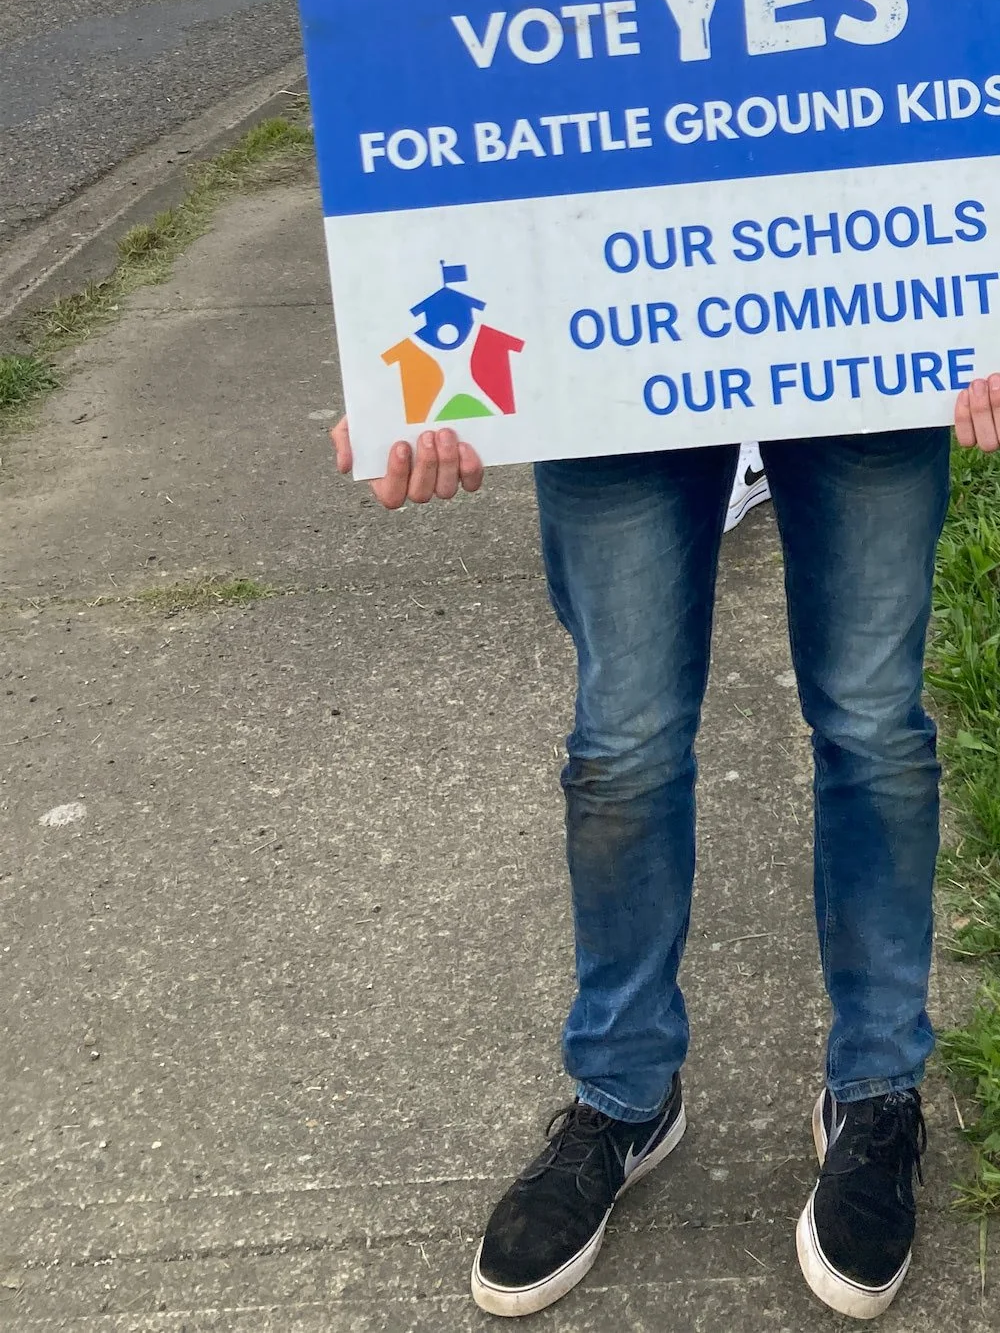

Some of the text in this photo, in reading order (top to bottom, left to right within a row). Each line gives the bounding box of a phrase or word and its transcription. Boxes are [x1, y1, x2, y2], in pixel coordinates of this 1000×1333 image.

[452, 1, 640, 68] VOTE
[360, 127, 463, 174] FOR
[475, 107, 652, 163] BATTLE
[665, 87, 884, 144] GROUND
[605, 200, 987, 274] OUR SCHOOLS
[570, 302, 681, 350] OUR
[643, 348, 976, 416] OUR FUTURE
